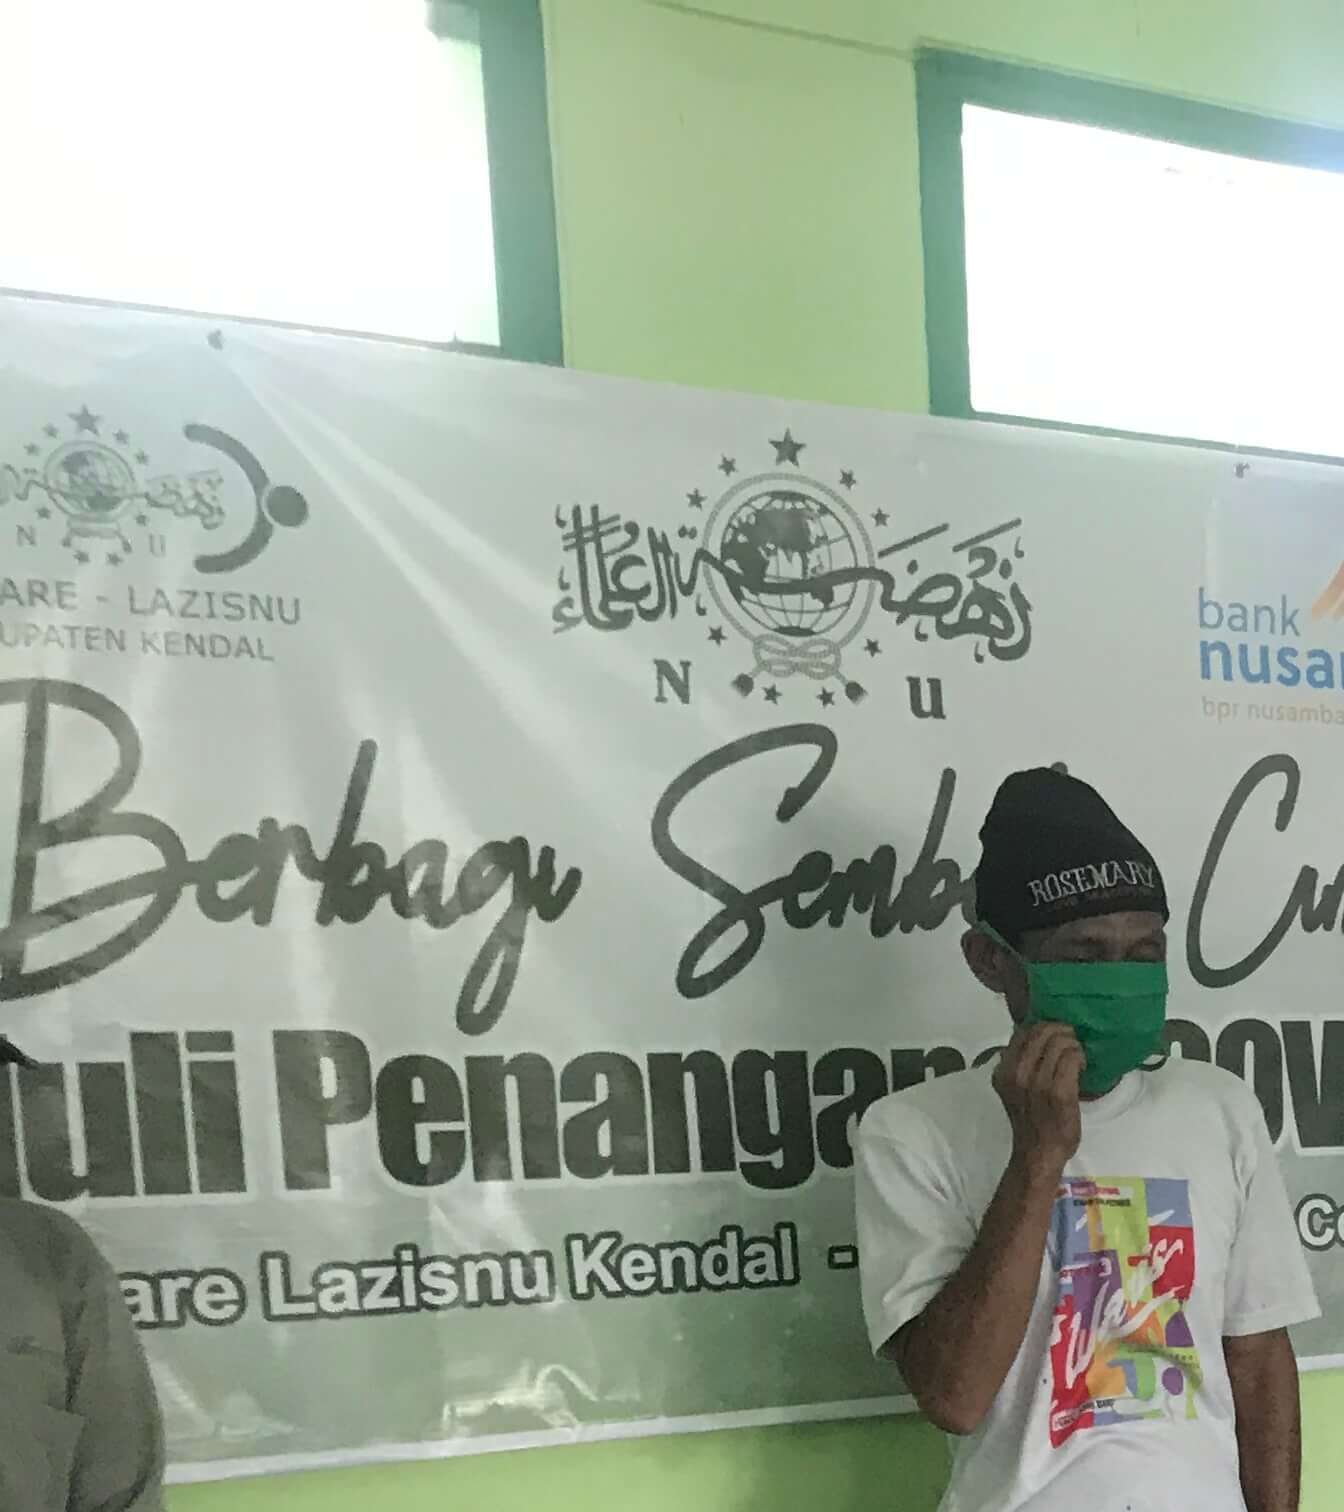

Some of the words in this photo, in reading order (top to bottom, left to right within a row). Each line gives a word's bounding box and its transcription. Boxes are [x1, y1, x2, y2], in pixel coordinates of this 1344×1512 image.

[0, 577, 78, 610] ARE
[128, 585, 300, 625] LAZISNU
[1199, 587, 1300, 637] bank
[0, 620, 126, 651] UPATEN
[141, 631, 275, 661] KENDAL
[654, 658, 691, 704] N
[1202, 697, 1239, 723] bpr
[651, 723, 978, 999] Semb
[1026, 860, 1155, 906] ROSEMARY
[0, 1030, 248, 1201] uli
[272, 1029, 1006, 1190] Penanga
[118, 1268, 248, 1329] are
[260, 1242, 552, 1323] Lazisnu
[566, 1223, 800, 1302] Kendal
